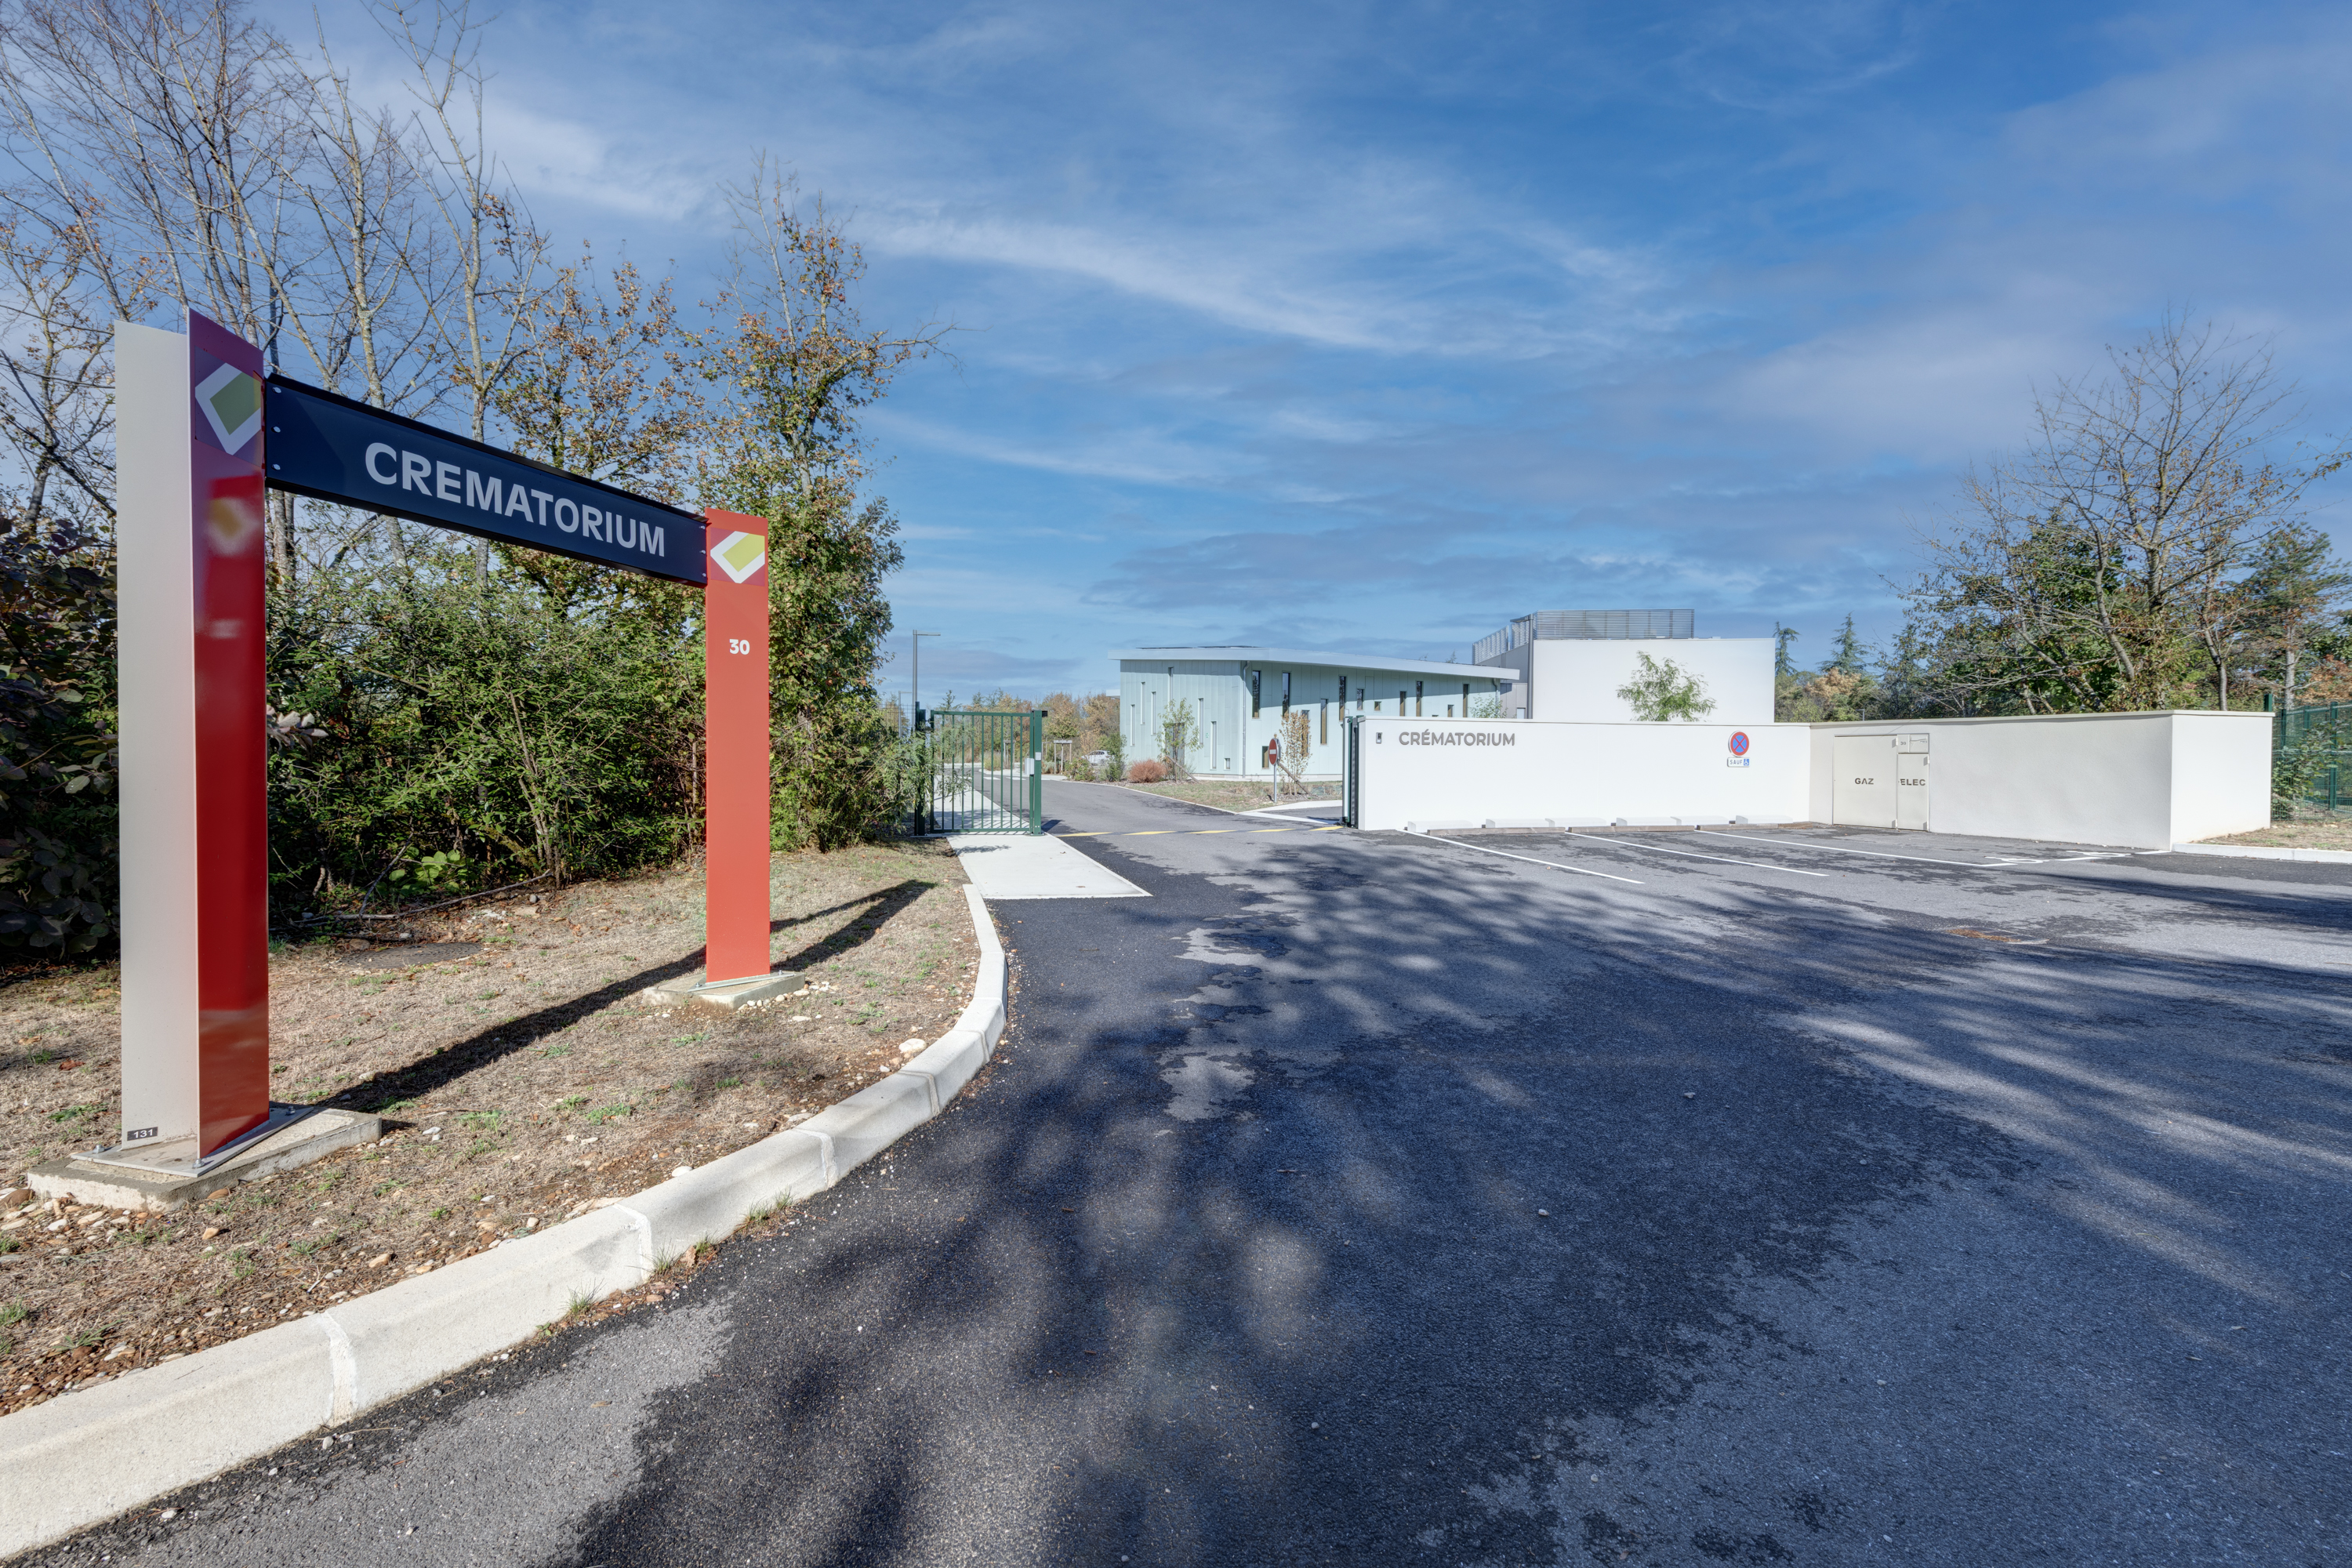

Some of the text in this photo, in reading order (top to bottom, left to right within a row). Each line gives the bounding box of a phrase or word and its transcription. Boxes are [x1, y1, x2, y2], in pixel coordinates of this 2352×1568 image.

[365, 442, 665, 557] CREMATORIUM
[729, 638, 750, 655] 30
[1399, 728, 1515, 746] CRÉMATORIUM
[133, 1129, 154, 1138] 131
